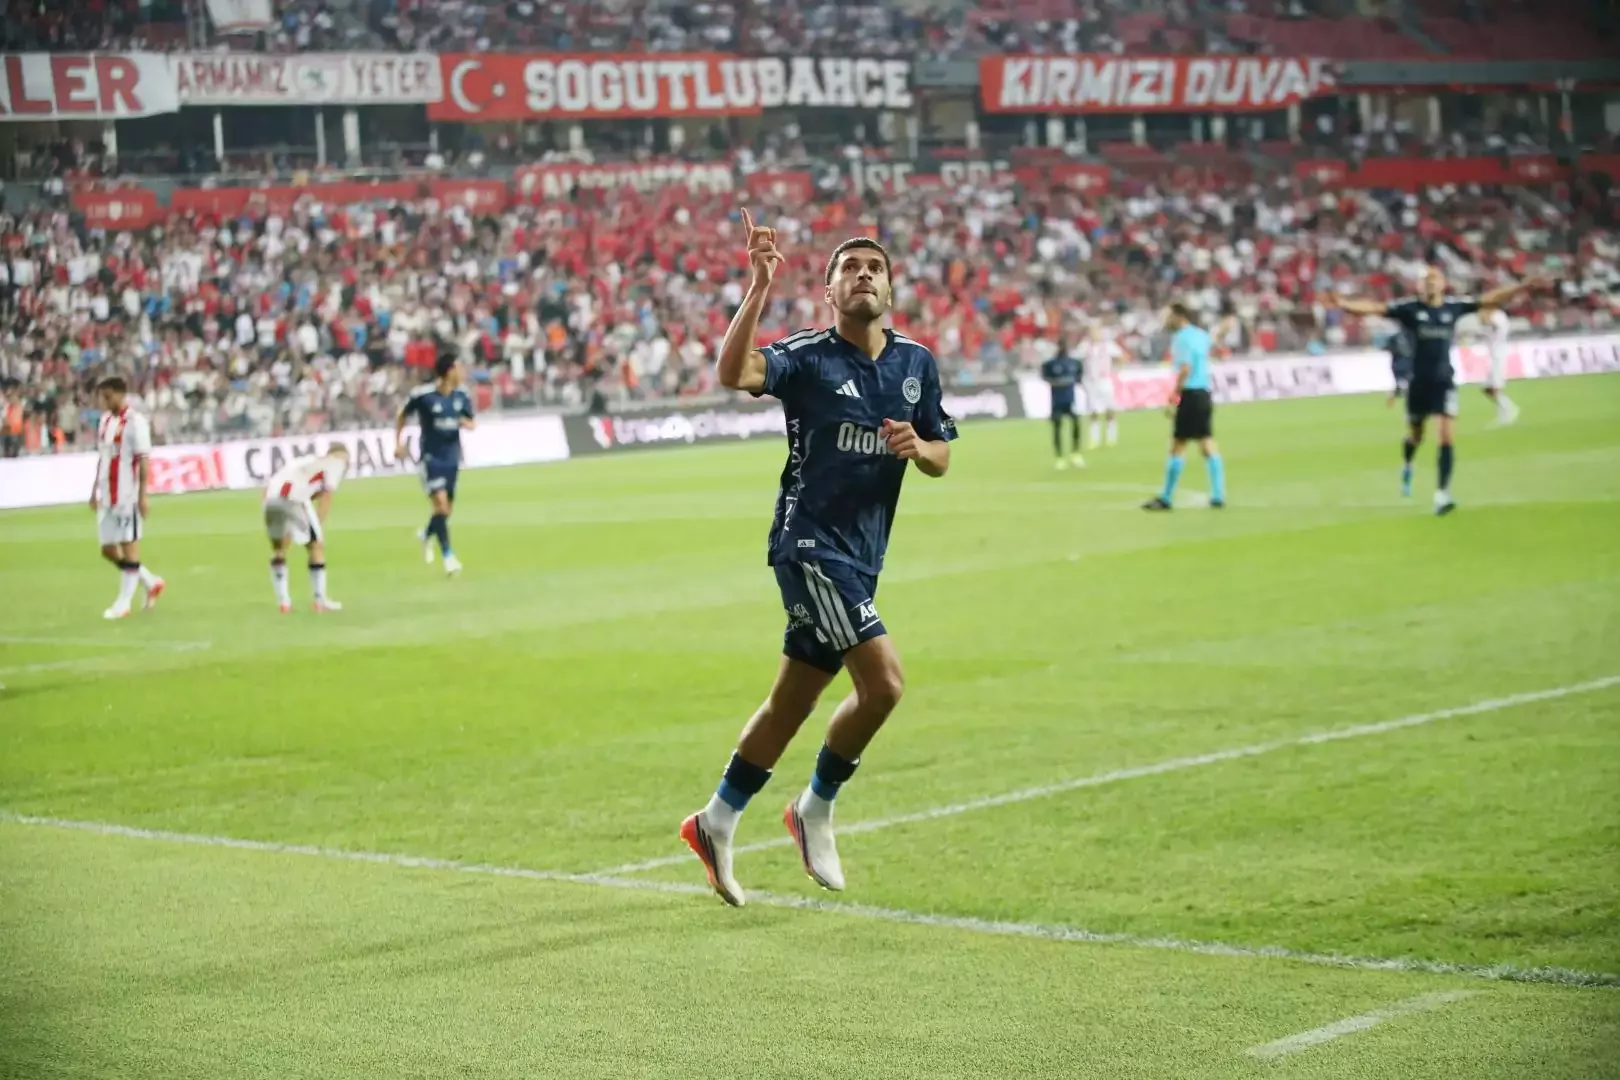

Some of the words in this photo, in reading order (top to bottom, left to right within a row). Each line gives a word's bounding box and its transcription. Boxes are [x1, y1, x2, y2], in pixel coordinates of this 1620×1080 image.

[0, 55, 144, 114] LER
[1001, 56, 1175, 106] KIRMIZI
[837, 422, 893, 455] Otok
